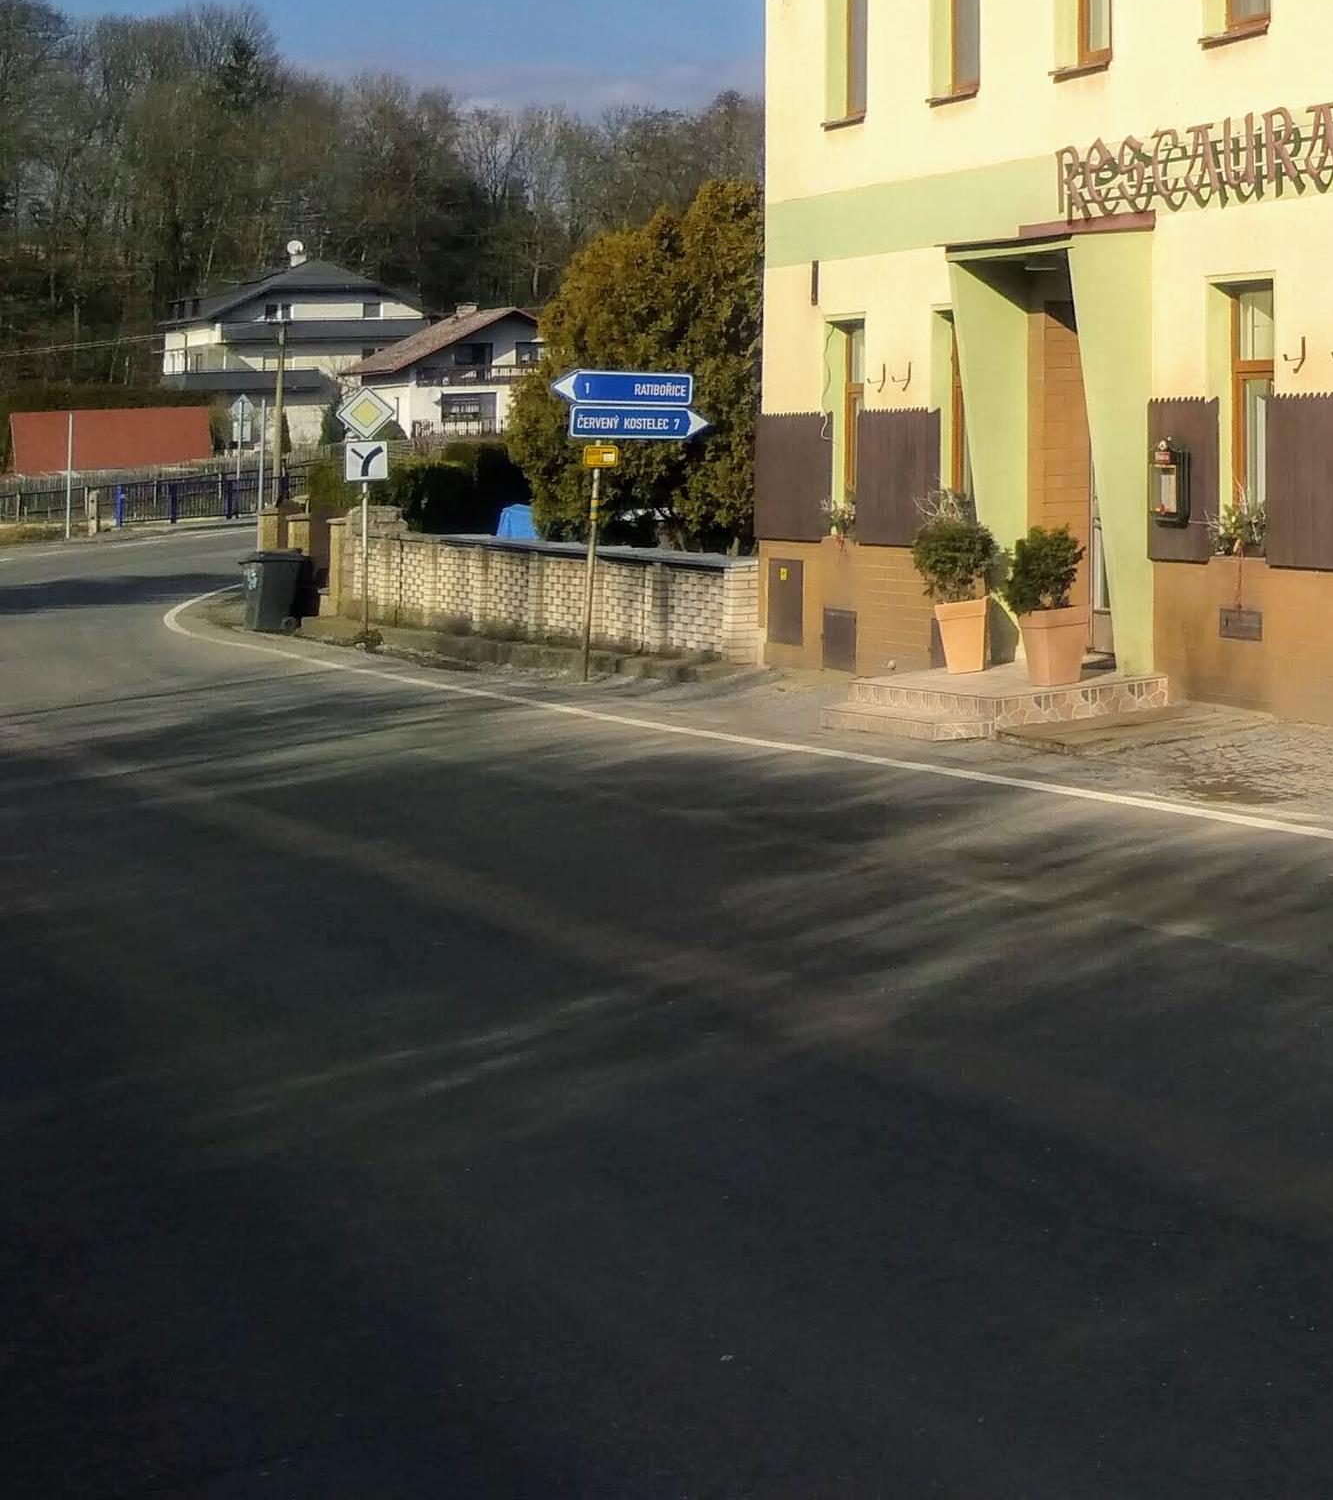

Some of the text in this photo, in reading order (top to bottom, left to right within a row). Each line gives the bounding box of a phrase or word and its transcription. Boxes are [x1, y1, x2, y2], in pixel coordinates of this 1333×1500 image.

[584, 382, 687, 397] 1 RATIBOŘICE
[576, 414, 681, 430] ČERVENÝ KOSTELEC 7
